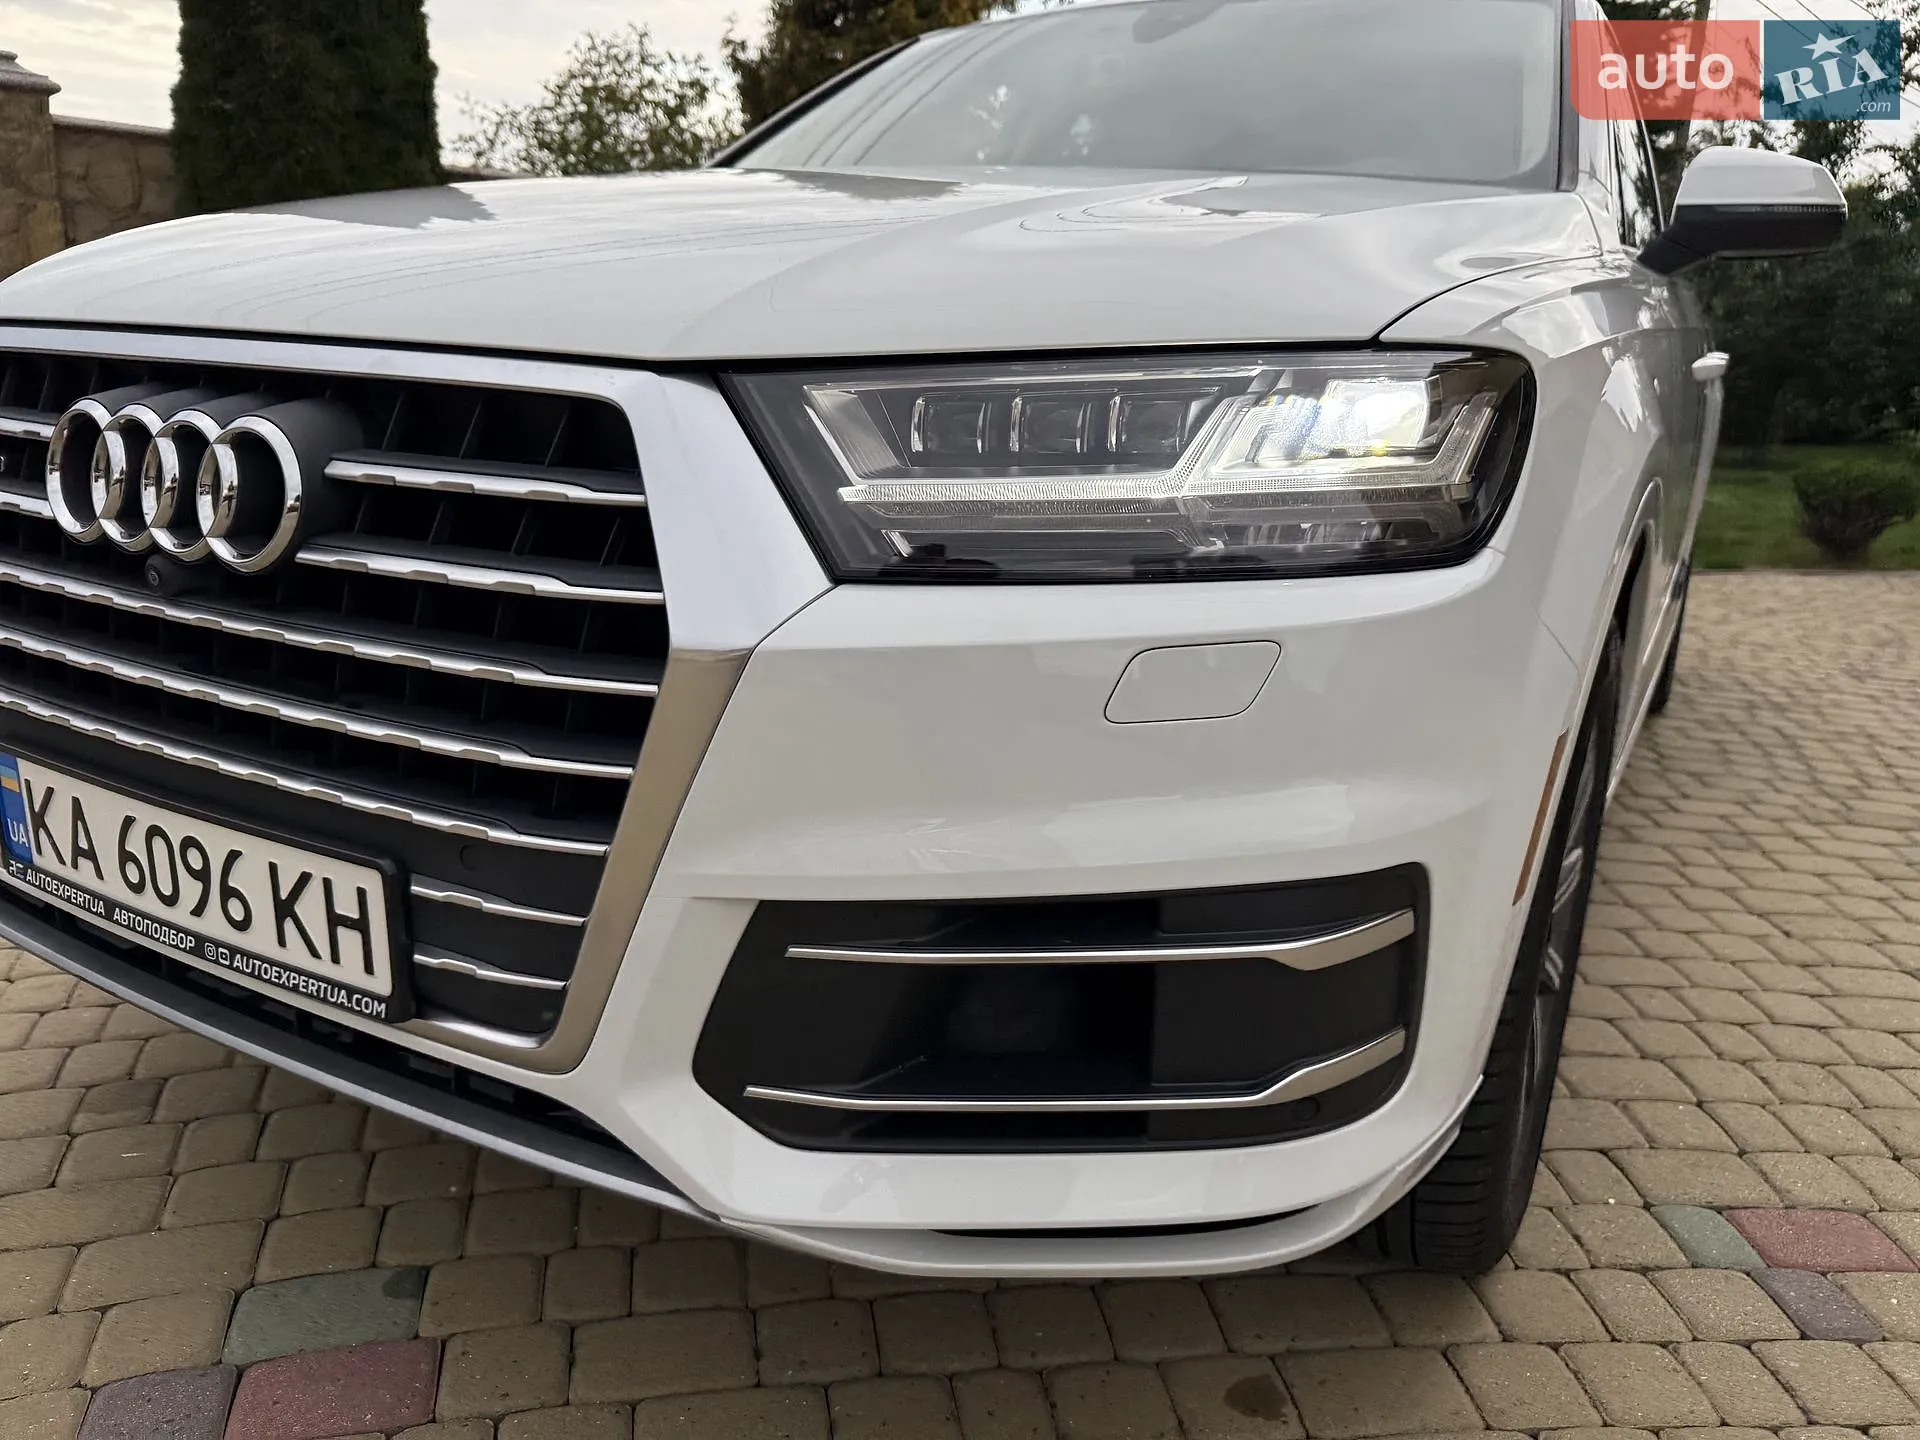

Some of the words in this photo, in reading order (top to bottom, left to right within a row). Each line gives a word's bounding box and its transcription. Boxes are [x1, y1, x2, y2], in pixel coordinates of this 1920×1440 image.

[8, 818, 28, 847] UA
[24, 778, 104, 881] KA
[117, 815, 253, 932] 6096
[269, 861, 375, 976] KH
[26, 869, 105, 916] AUTOEXPERTUA
[113, 907, 195, 951] АВТОПОДБОР
[233, 953, 387, 1019] AUTOEXPERTUA.COM
